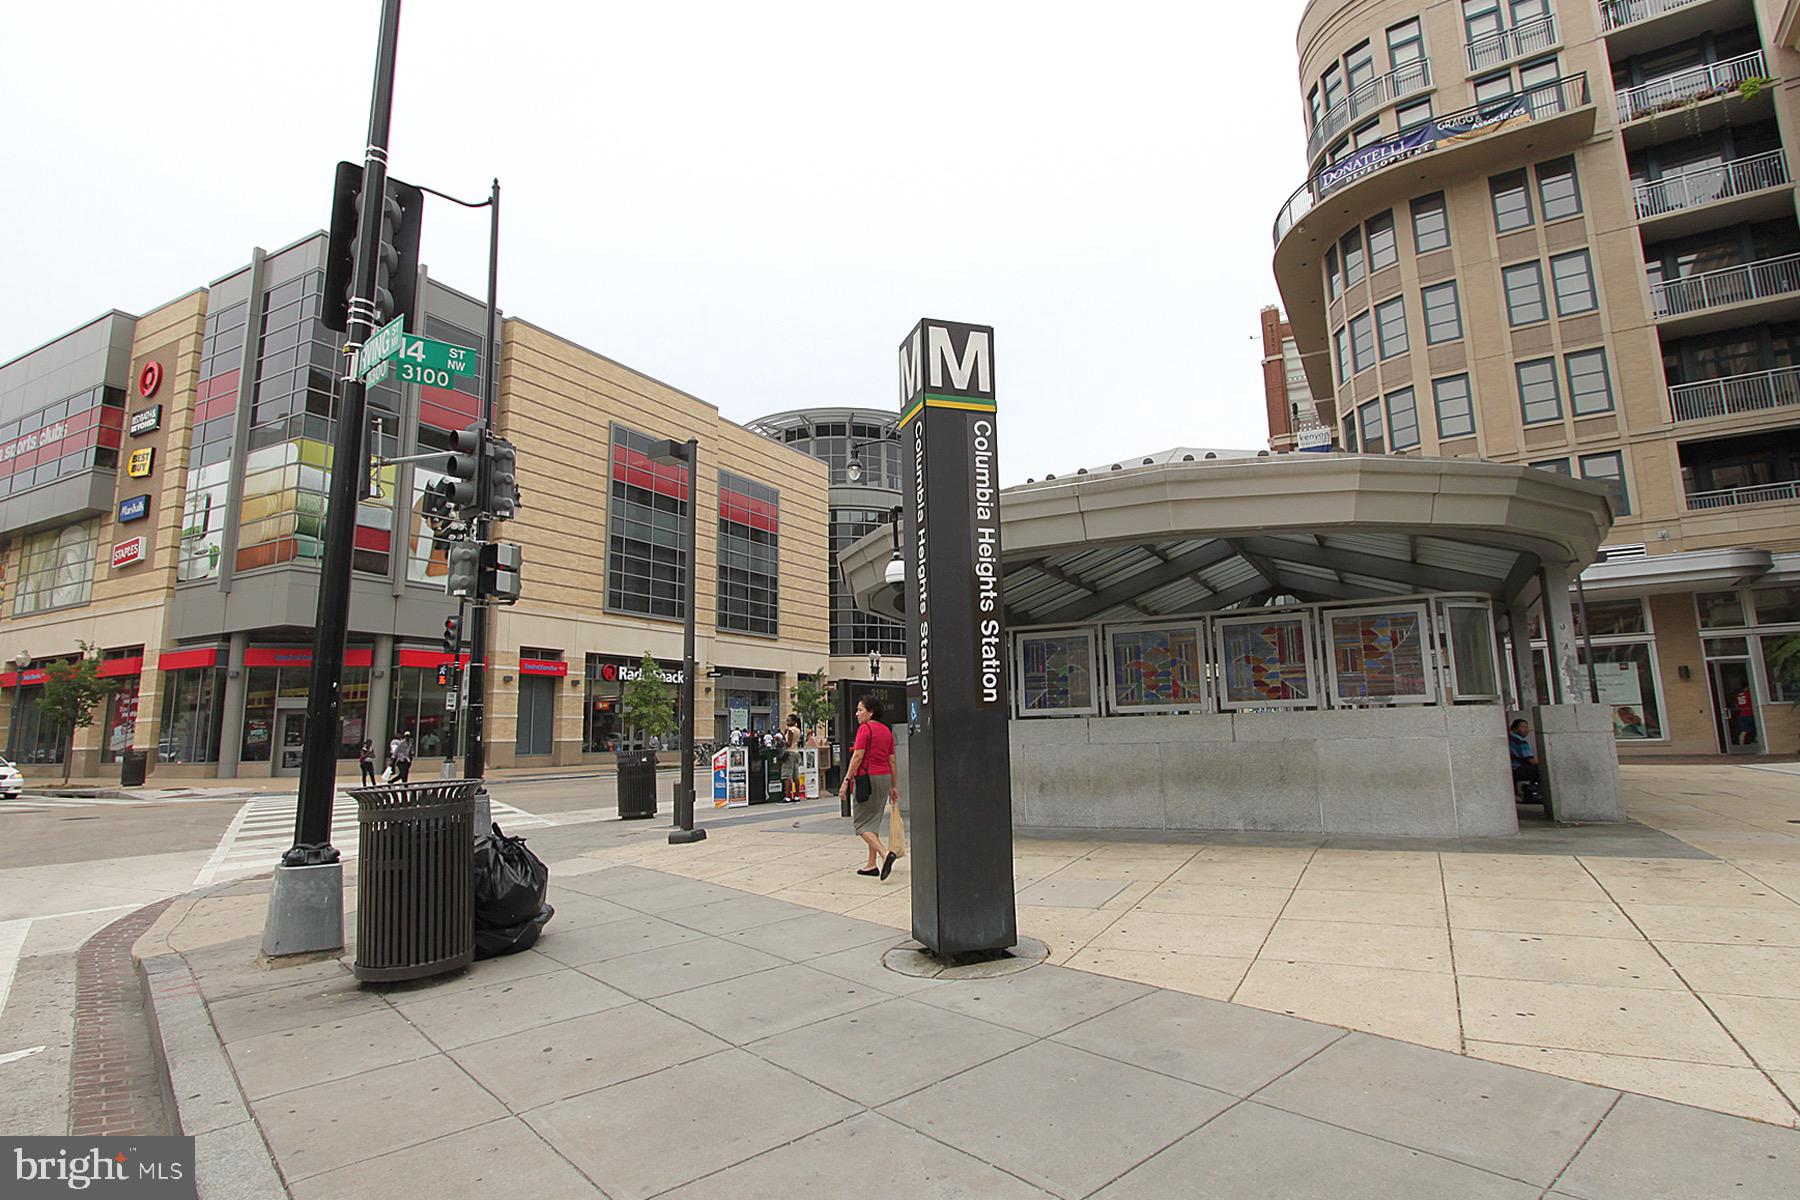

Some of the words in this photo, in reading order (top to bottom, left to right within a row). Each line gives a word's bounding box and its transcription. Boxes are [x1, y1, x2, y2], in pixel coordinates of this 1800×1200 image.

[1471, 107, 1527, 130] Associates
[1322, 141, 1405, 187] DONATELLI
[1345, 144, 1431, 183] DEVELOPMENT
[362, 328, 390, 366] RVING
[399, 337, 426, 362] 14
[449, 348, 466, 360] ST
[447, 360, 466, 371] NW
[928, 325, 991, 393] M
[402, 364, 449, 387] 3100
[900, 328, 922, 408] M
[131, 419, 156, 433] BEYOND
[131, 463, 147, 473] BUY
[132, 452, 149, 463] BEST
[914, 420, 926, 522] Columbia
[974, 420, 994, 520] Columbia
[120, 501, 144, 517] Marshalls
[114, 543, 139, 562] STAPLES
[916, 528, 927, 614] Heights
[975, 527, 998, 612] Heights
[919, 621, 929, 705] Station
[980, 619, 1000, 703] Station
